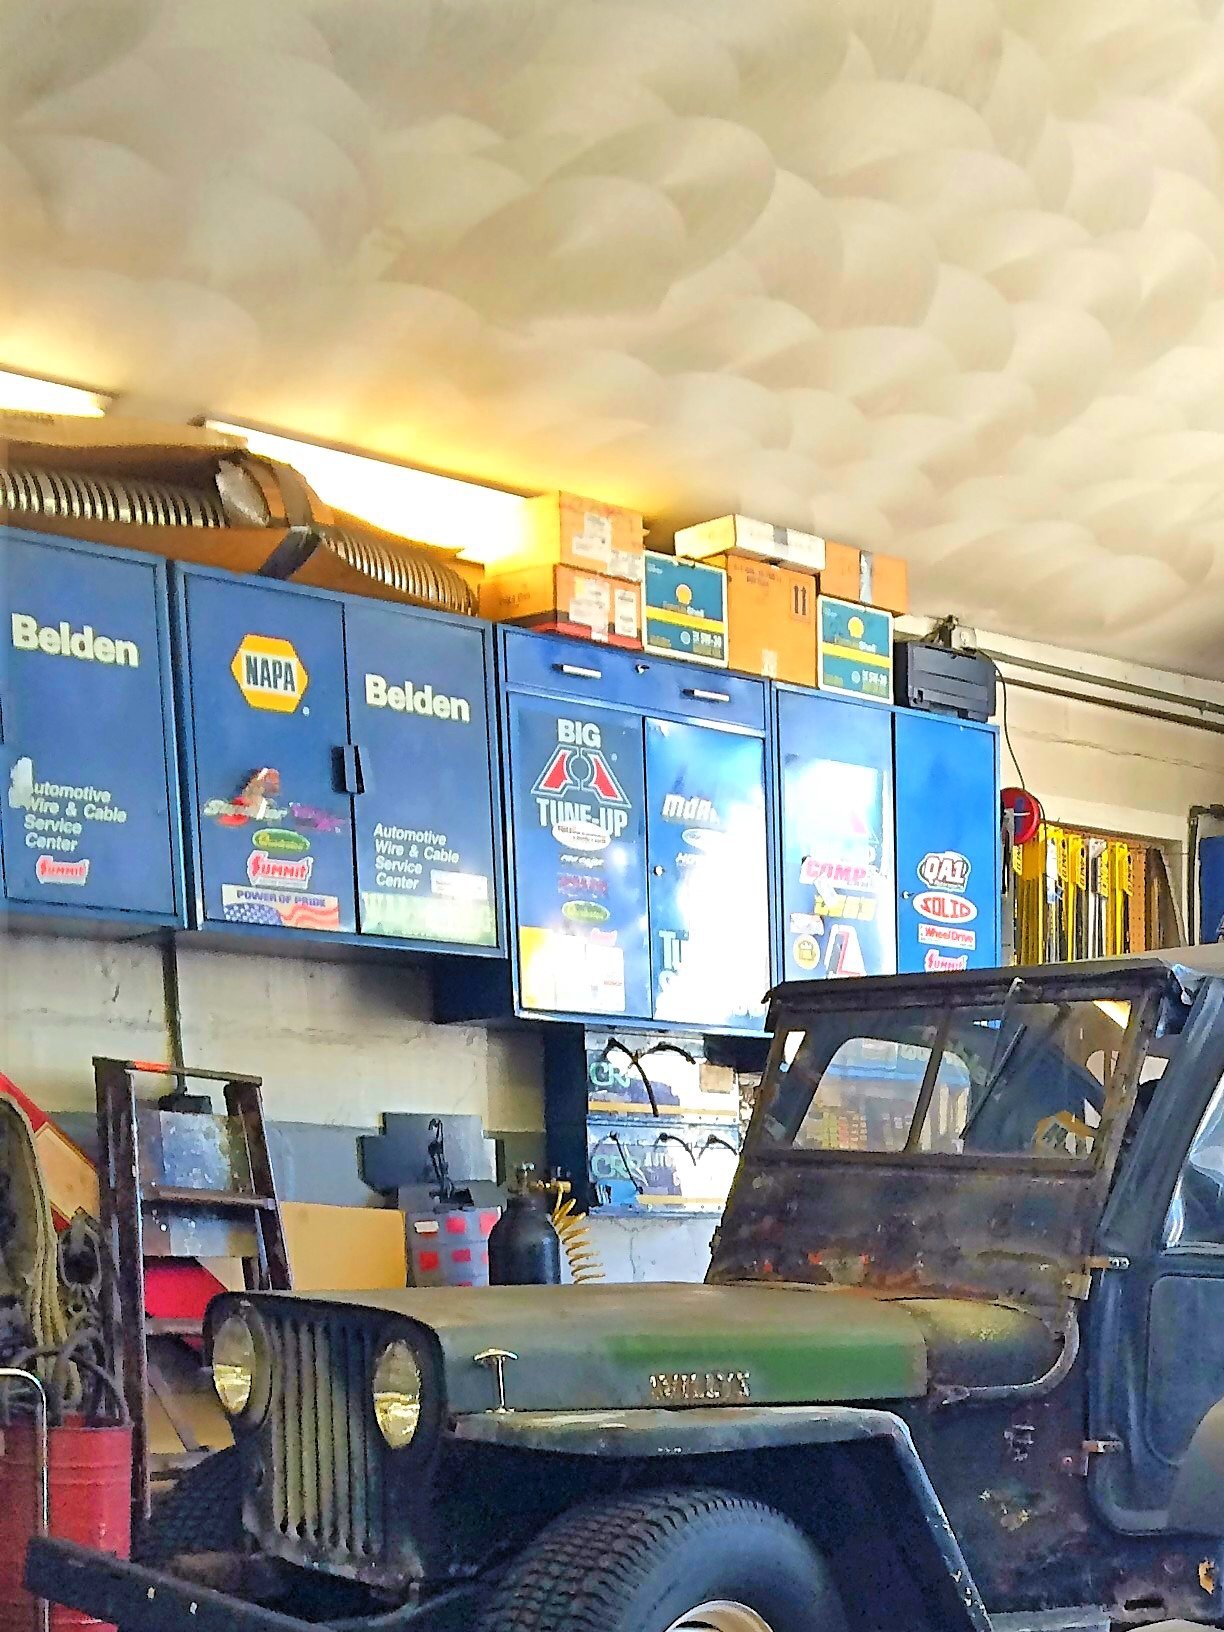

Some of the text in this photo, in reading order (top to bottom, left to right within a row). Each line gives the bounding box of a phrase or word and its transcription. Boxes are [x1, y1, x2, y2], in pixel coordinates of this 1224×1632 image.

[12, 612, 139, 668] Belden
[245, 654, 296, 692] NAPA
[366, 673, 469, 723] Belden
[557, 718, 602, 749] BIG
[33, 782, 111, 803] utomotive
[66, 801, 77, 817] &
[84, 803, 127, 823] Cable
[535, 797, 628, 838] TUNE-UP
[24, 813, 83, 835] Service
[373, 823, 447, 846] Automotive
[25, 832, 78, 852] Center
[375, 839, 459, 864] Wire & Cable
[375, 855, 423, 875] Service
[923, 855, 966, 885] QA1
[376, 872, 419, 890] Center
[236, 890, 326, 908] POWER OF PRIDE
[920, 896, 972, 919] SOLID
[925, 926, 952, 941] Wheel
